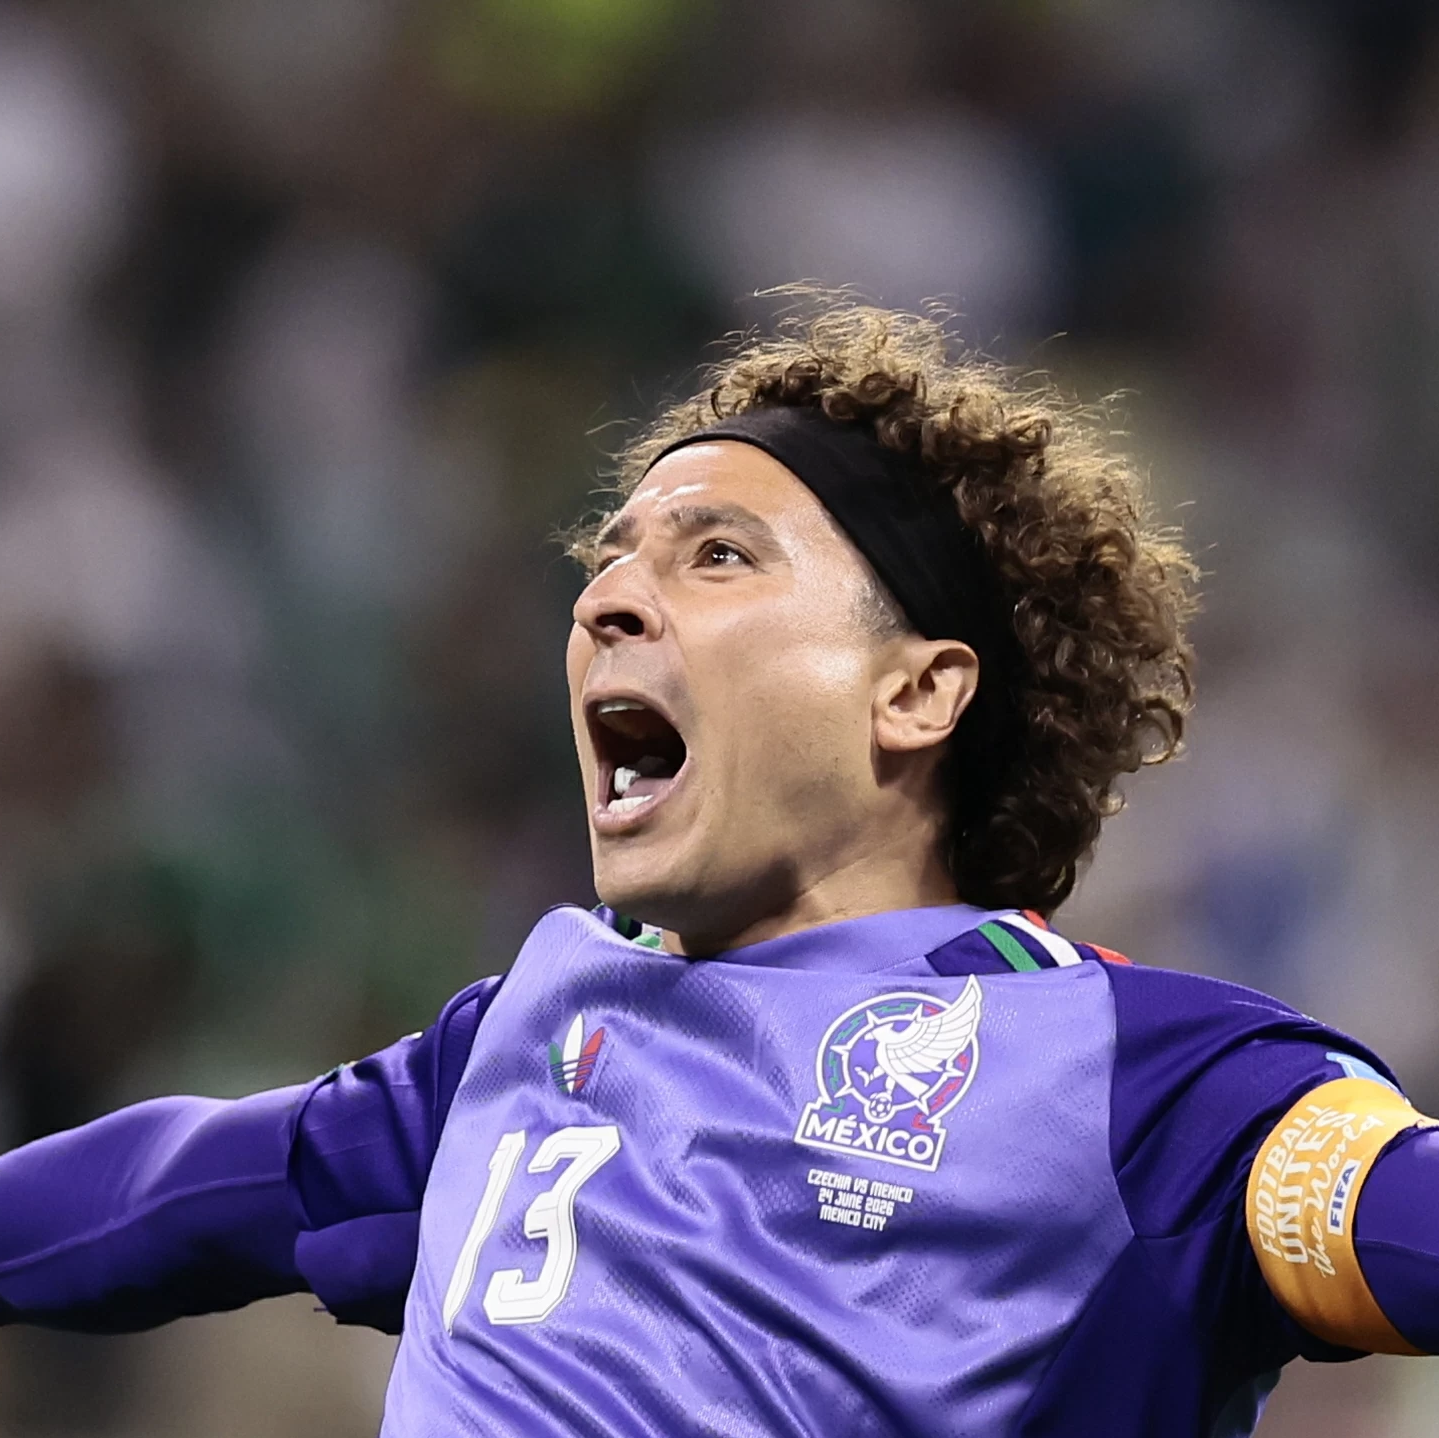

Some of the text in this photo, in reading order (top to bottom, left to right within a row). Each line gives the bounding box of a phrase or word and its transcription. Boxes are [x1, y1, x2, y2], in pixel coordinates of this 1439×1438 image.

[805, 1114, 934, 1161] MÉXICO
[807, 1168, 913, 1203] CZECHIA VS MEXICO
[818, 1187, 895, 1216] 24 JUNE 2026
[1256, 1105, 1332, 1258] FOOTBALL
[1276, 1111, 1356, 1263] UNITES
[1330, 1166, 1356, 1228] FIFA
[442, 1126, 621, 1337] 13
[820, 1204, 887, 1231] MEXICO CITY
